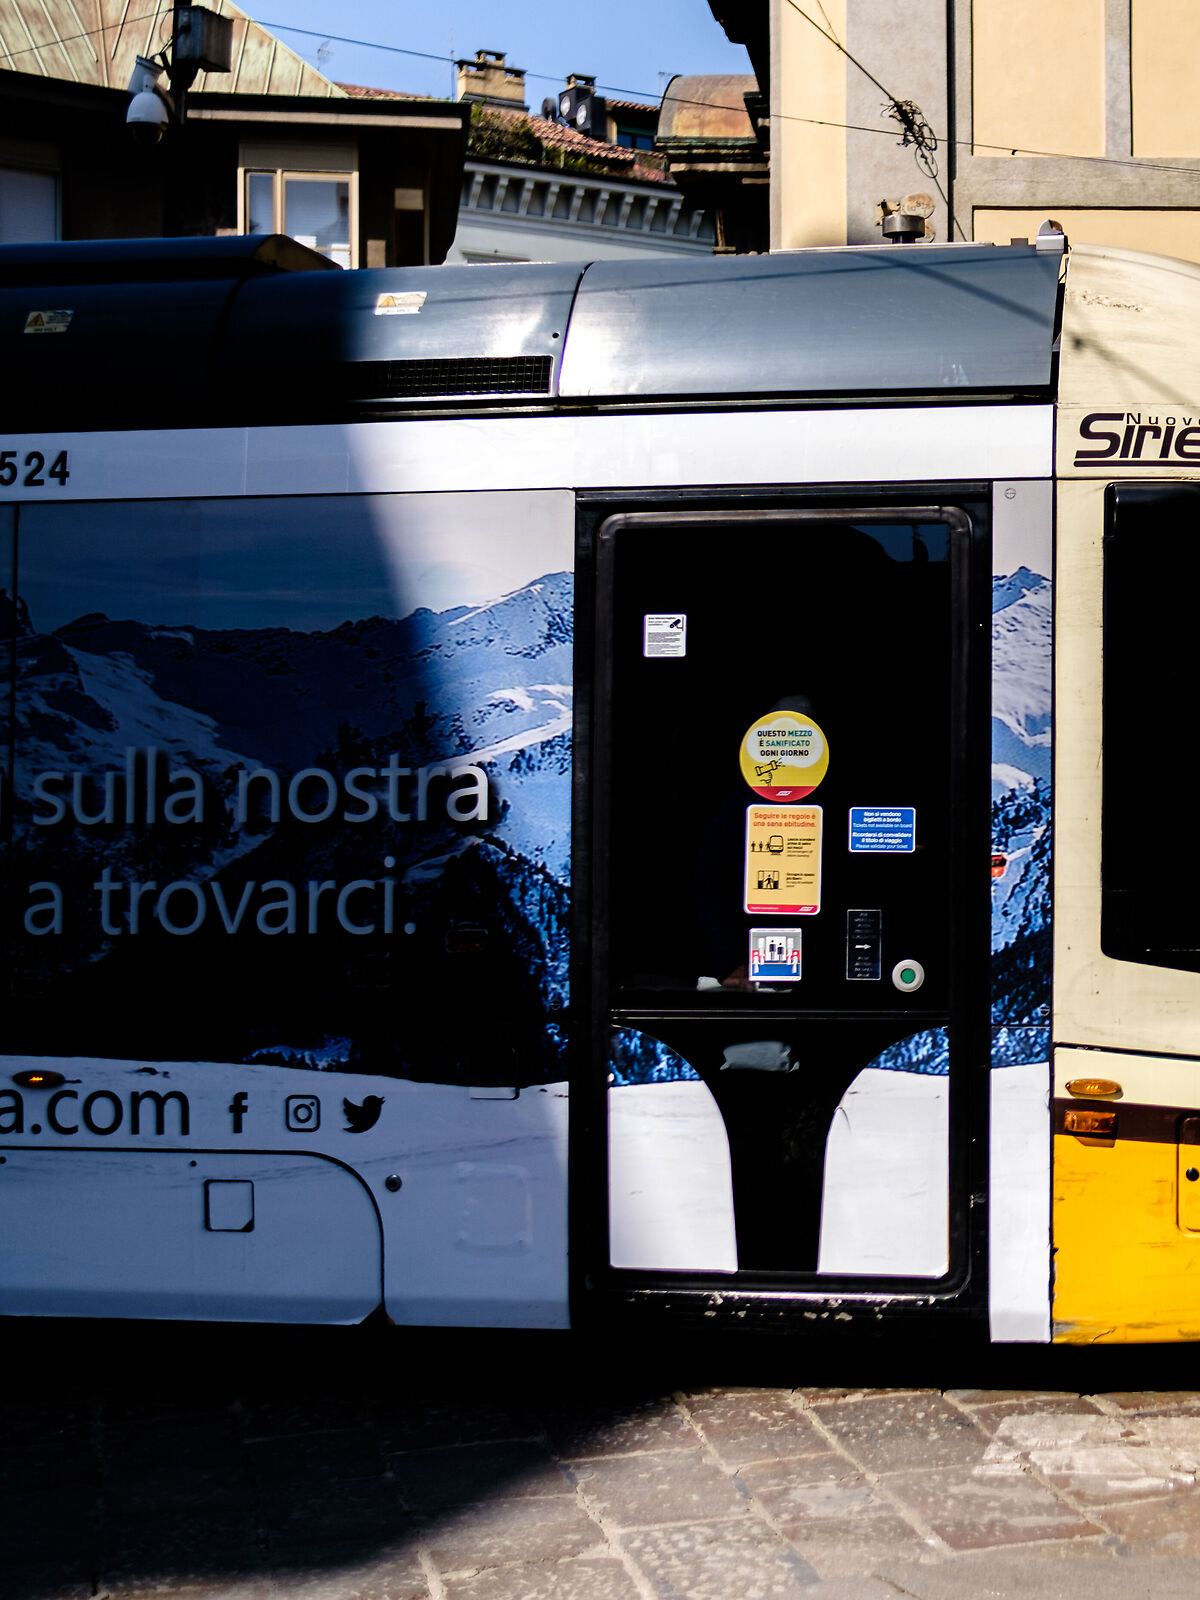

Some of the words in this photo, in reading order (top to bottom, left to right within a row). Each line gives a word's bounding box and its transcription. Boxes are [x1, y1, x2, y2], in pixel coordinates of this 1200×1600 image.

[0, 450, 70, 487] 524
[32, 745, 203, 826] sulla
[236, 752, 489, 823] nostra
[23, 880, 64, 936] a
[93, 855, 418, 936] trovarci.
[0, 1088, 191, 1137] a.com
